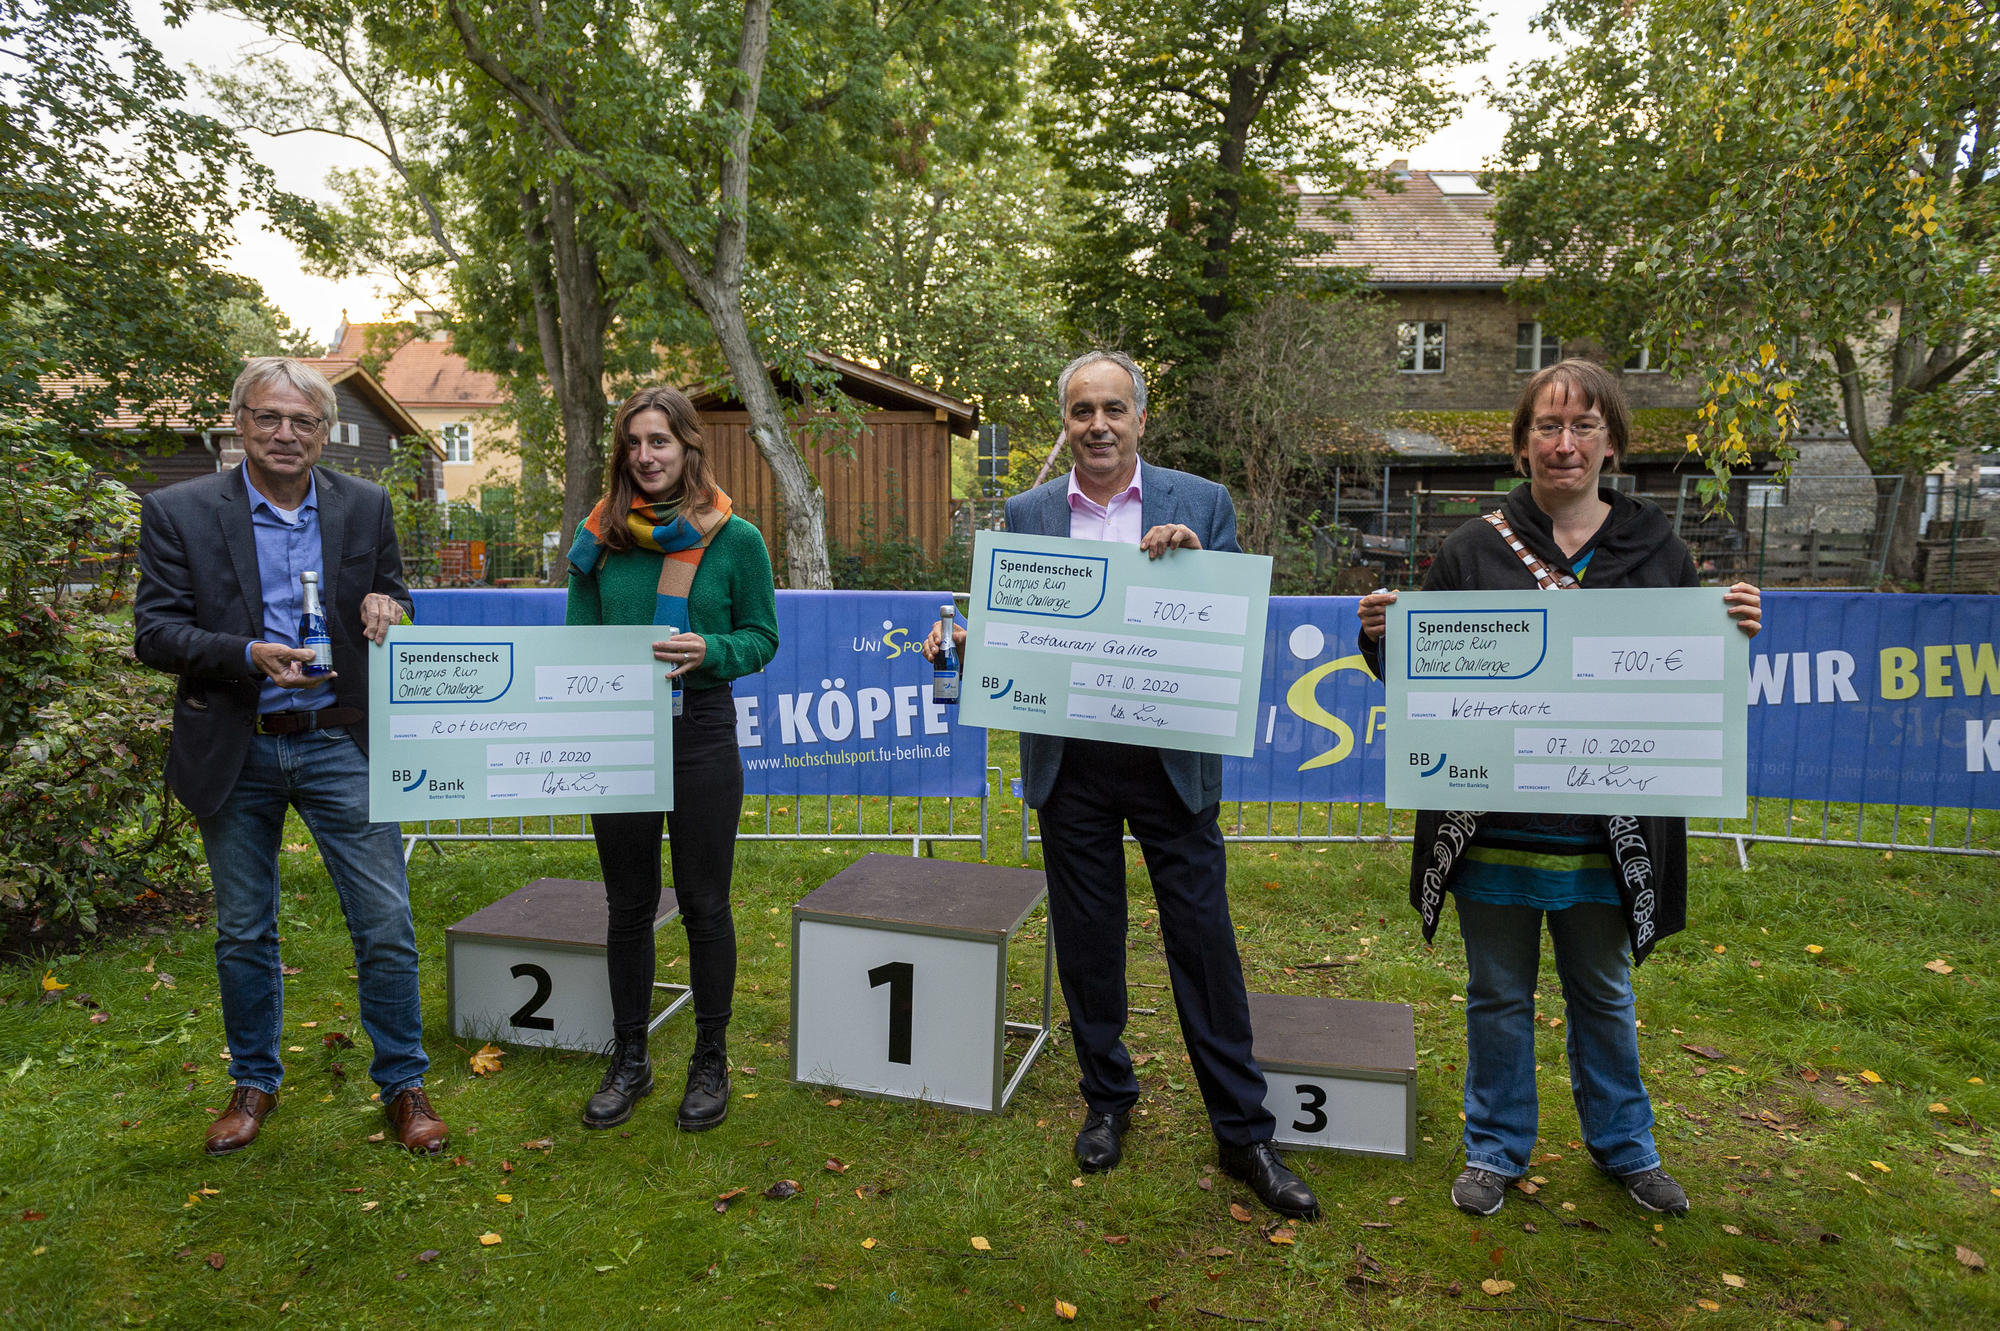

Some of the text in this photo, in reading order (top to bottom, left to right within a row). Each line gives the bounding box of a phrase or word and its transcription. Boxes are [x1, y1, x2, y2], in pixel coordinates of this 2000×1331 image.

[1000, 560, 1093, 578] Spendenscheck
[998, 575, 1066, 593] Campus Run
[995, 591, 1072, 612] Online Challenge
[1418, 620, 1530, 635] Spendenscheck
[1018, 630, 1158, 658] Restaurant Galileo
[1416, 636, 1497, 656] Campus Run
[400, 652, 499, 665] Spendenscheck
[1415, 656, 1511, 677] Online Challenge
[399, 666, 477, 681] Campus Run
[1747, 643, 2000, 705] WIR BEW
[398, 682, 484, 699] Online Challenge
[981, 676, 1047, 705] BB Bank
[778, 677, 950, 745] KÖPFE
[1451, 697, 1552, 718] Wetterkarte
[431, 719, 528, 735] Rotbuchen
[746, 742, 951, 772] www.hochschulsport.fu-berlin.de
[1409, 752, 1489, 779] BB Bank
[392, 770, 465, 792] BB Bank
[509, 963, 554, 1031] 2
[868, 961, 914, 1066] 1
[1291, 1084, 1328, 1133] 3
